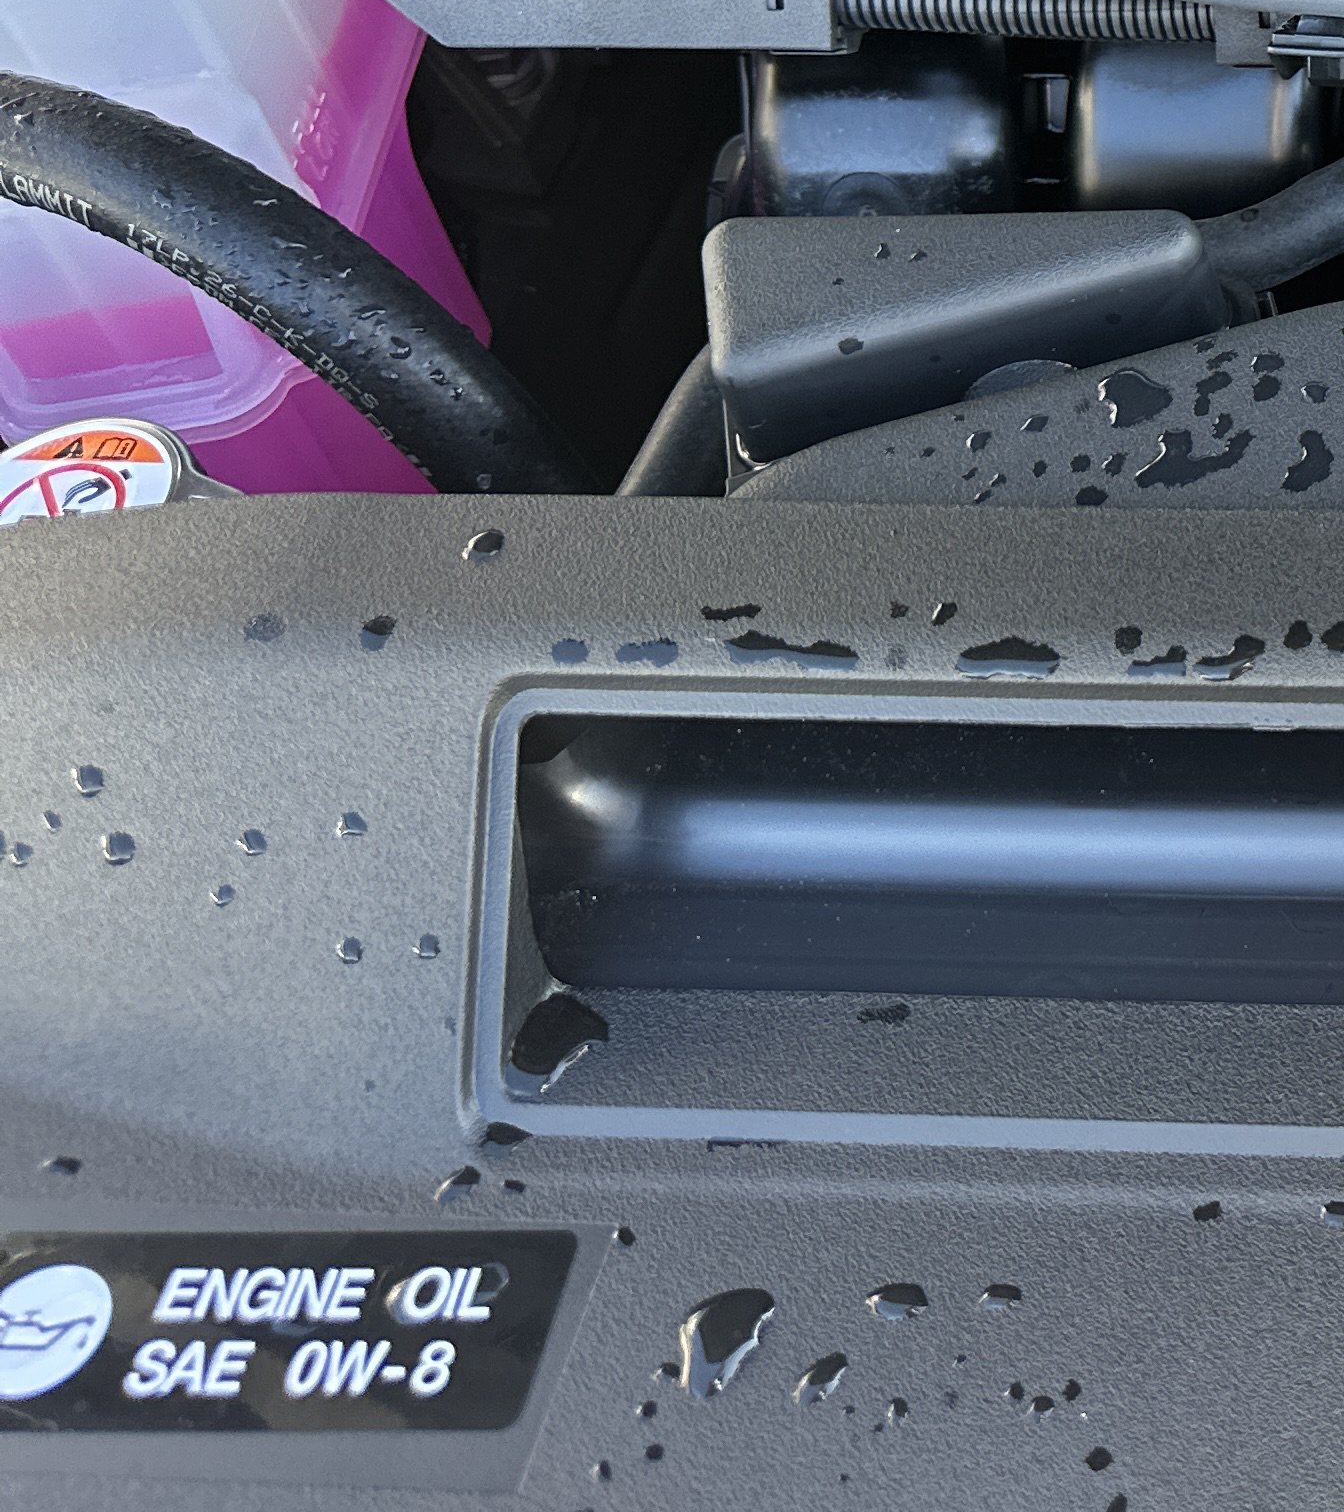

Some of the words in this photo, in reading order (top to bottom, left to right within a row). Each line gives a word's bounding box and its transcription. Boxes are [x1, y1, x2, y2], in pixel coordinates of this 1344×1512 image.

[151, 1266, 376, 1324] ENGINE
[400, 1265, 492, 1325] OIL
[122, 1338, 256, 1399] SAE
[281, 1338, 457, 1400] 0W-8
